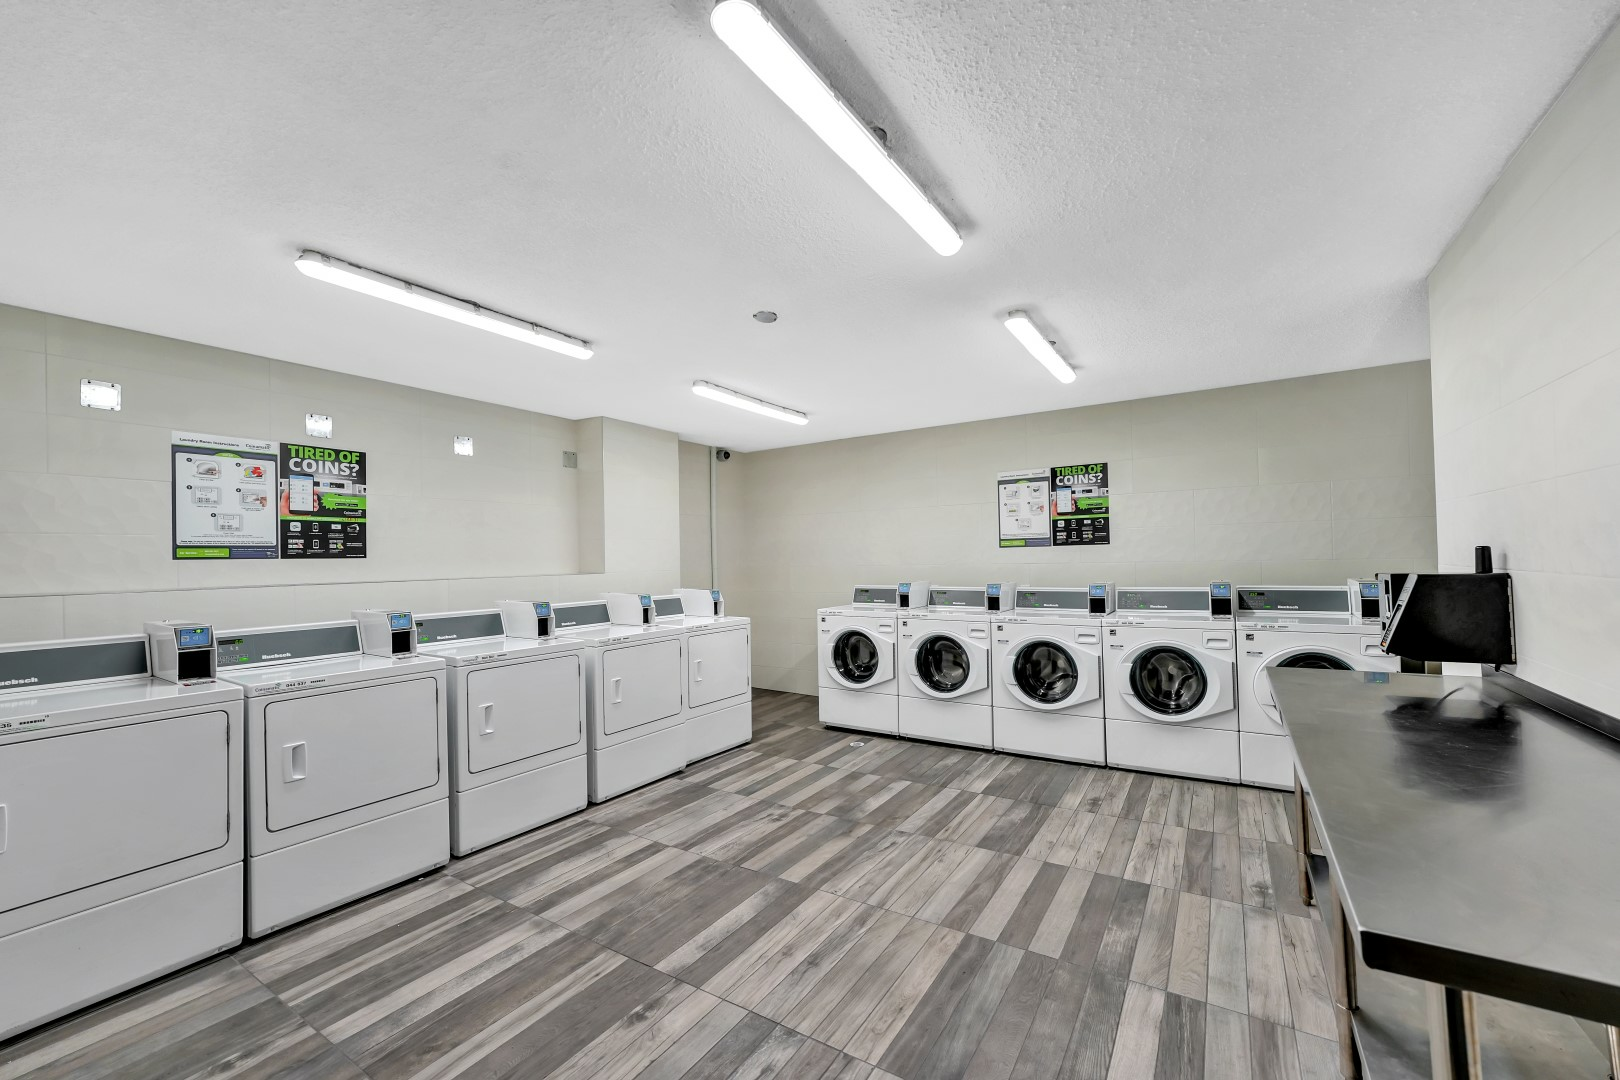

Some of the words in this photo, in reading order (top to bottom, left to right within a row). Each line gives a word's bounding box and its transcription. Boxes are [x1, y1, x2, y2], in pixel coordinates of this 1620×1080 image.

[287, 445, 335, 461] TIRED
[339, 451, 360, 464] OF
[288, 458, 360, 476] COINS?
[1055, 466, 1086, 477] TIRED
[1087, 464, 1103, 474] OF
[1055, 473, 1103, 485] COINS?
[0, 677, 39, 686] uebsch
